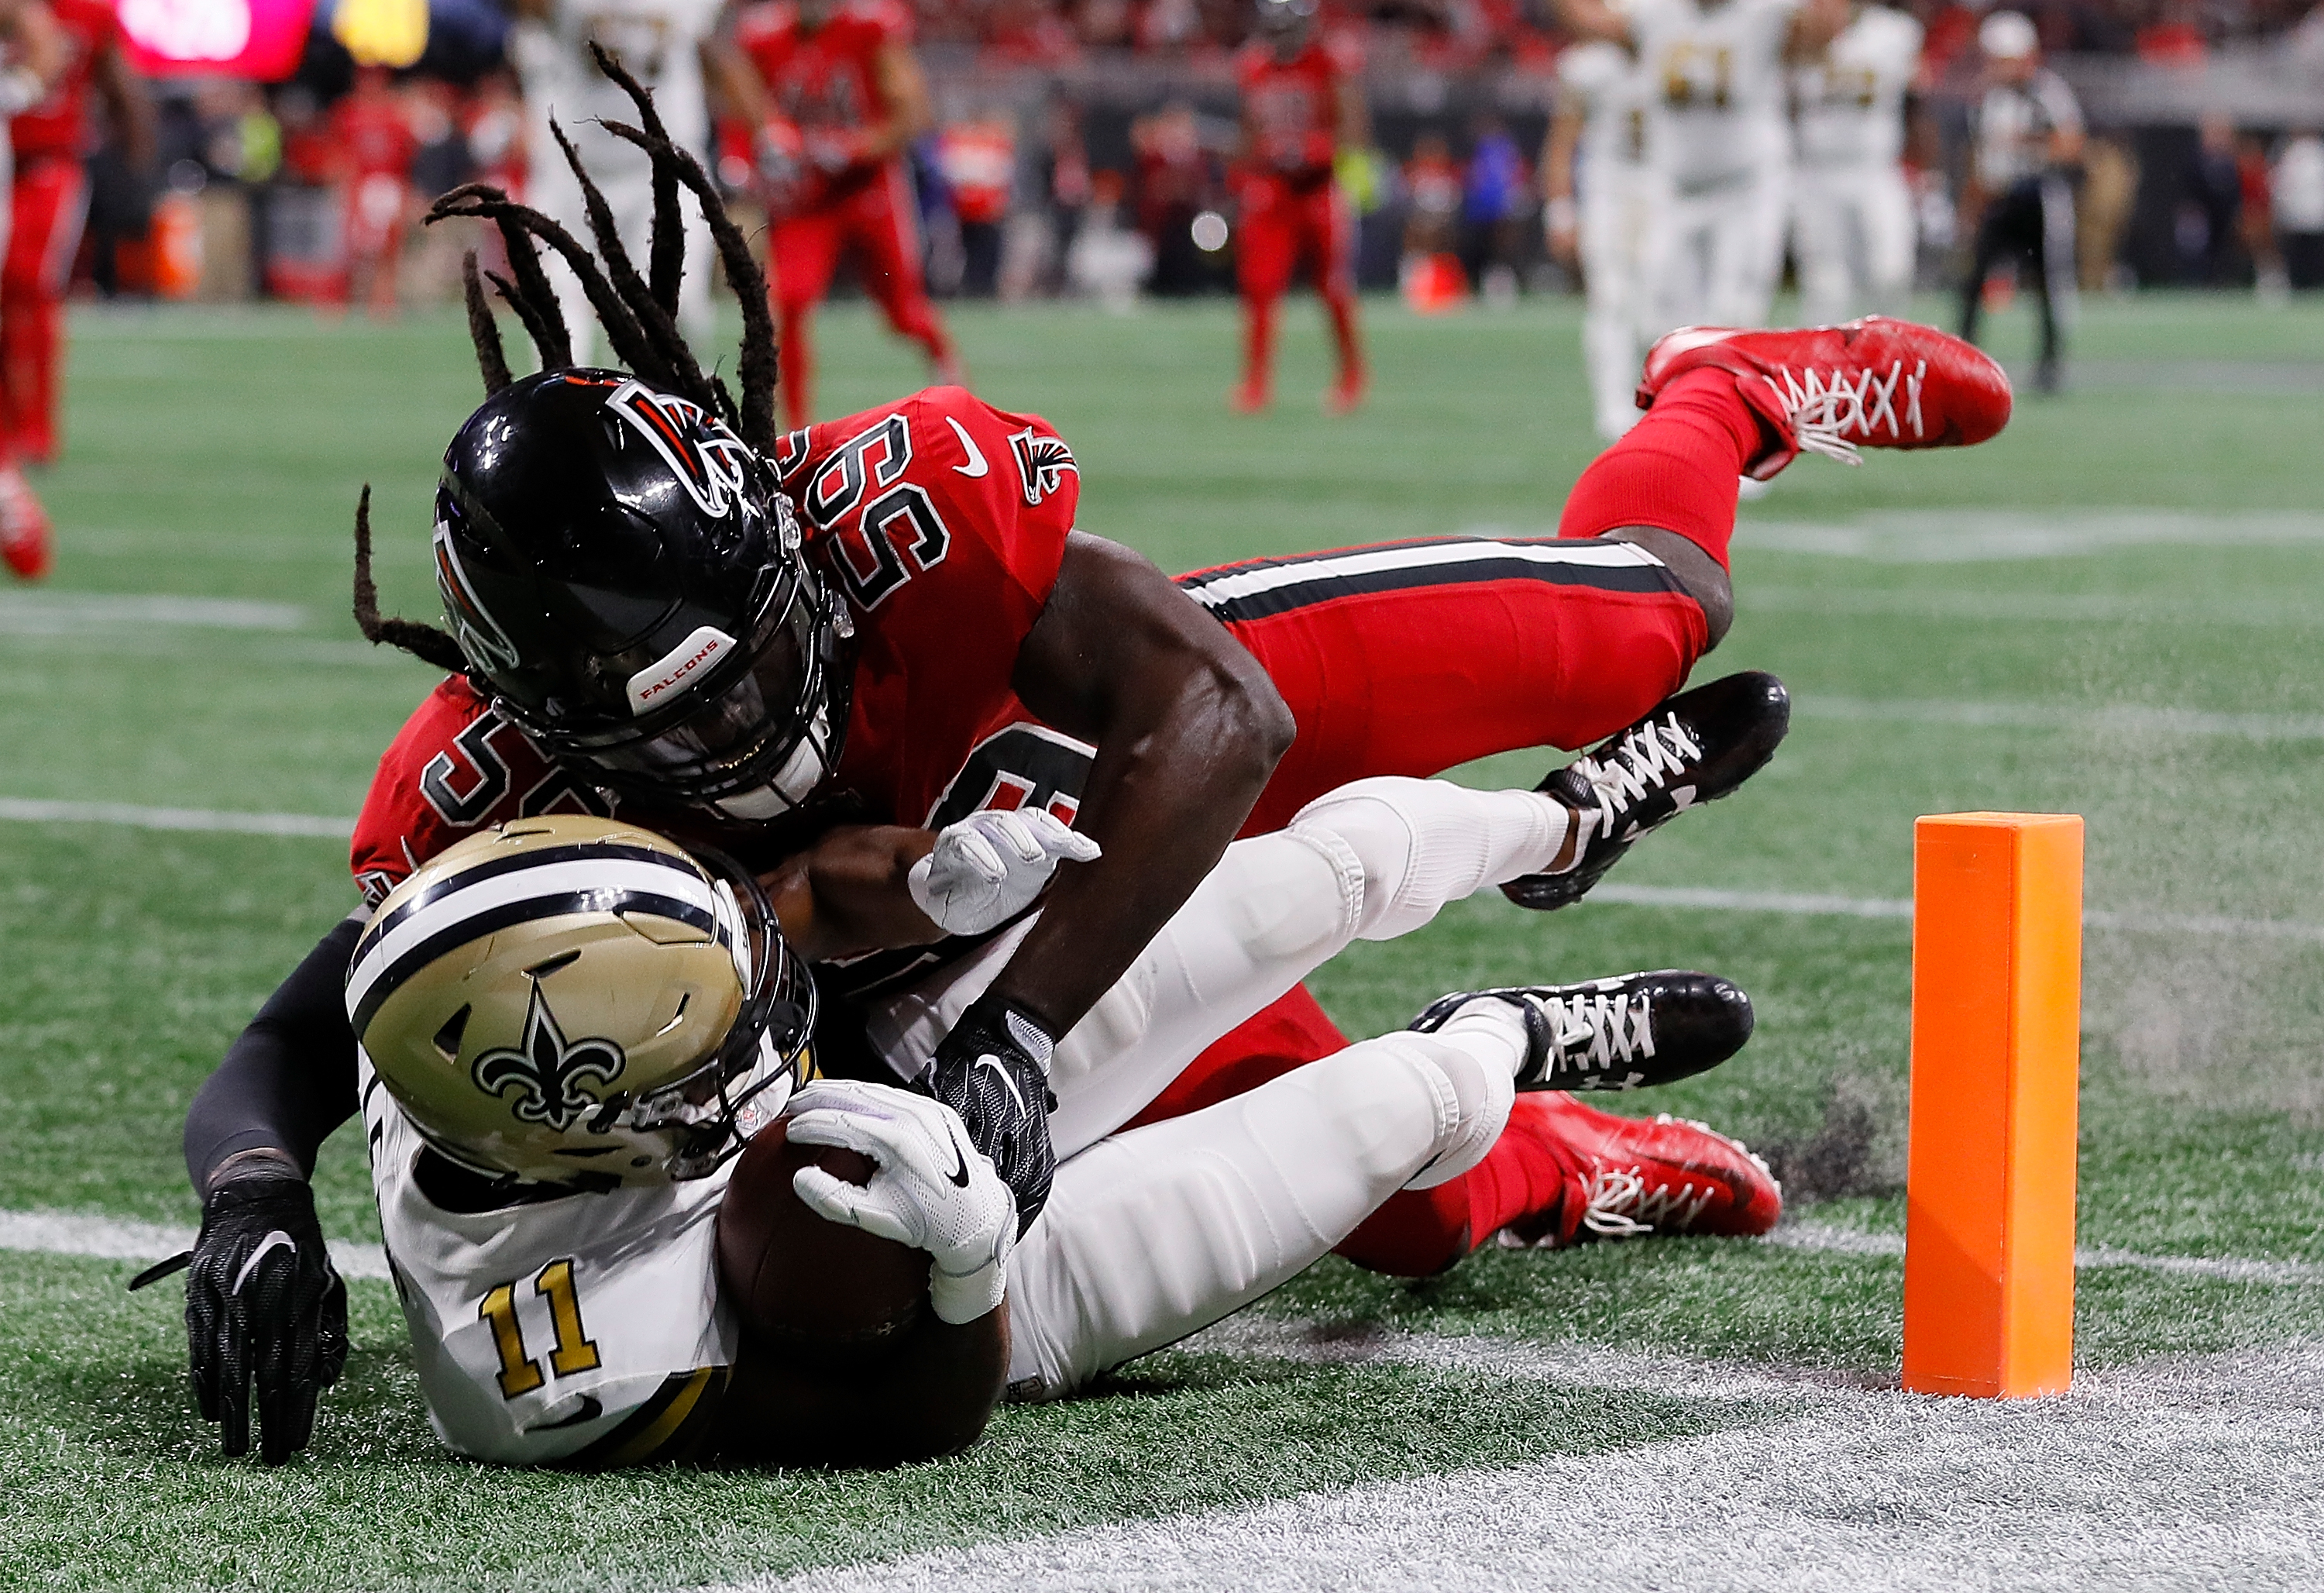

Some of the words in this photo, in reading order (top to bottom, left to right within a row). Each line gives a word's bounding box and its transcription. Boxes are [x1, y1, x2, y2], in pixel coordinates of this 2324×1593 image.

[804, 412, 951, 613] 59
[639, 639, 719, 700] FALCONS
[477, 1257, 603, 1401] 11
